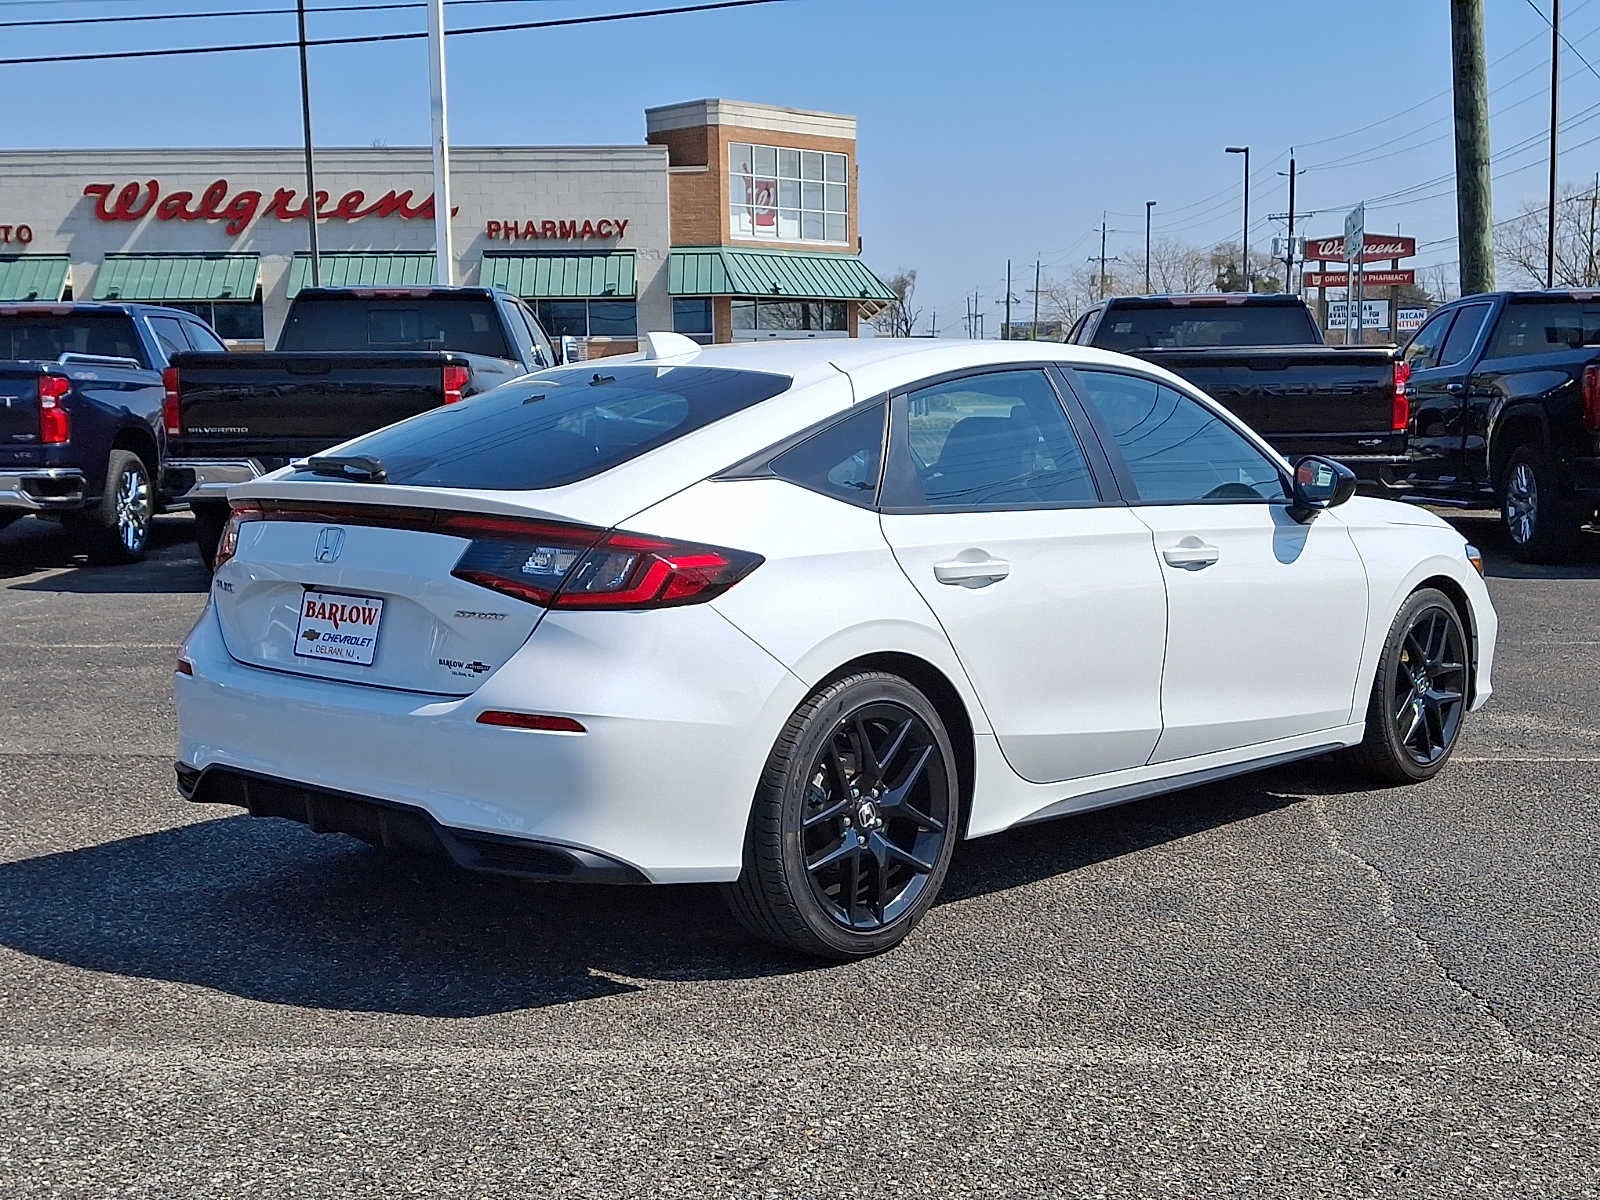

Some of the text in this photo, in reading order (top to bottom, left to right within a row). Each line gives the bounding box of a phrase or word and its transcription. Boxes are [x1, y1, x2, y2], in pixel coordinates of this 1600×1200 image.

[486, 219, 630, 240] PHARMACY
[1369, 273, 1409, 282] PHARMACY
[1400, 312, 1425, 320] RICAN
[304, 600, 379, 630] BARLOW
[321, 632, 374, 648] CHEVROLET
[345, 648, 355, 658] NJ
[438, 658, 465, 670] BARLOW
